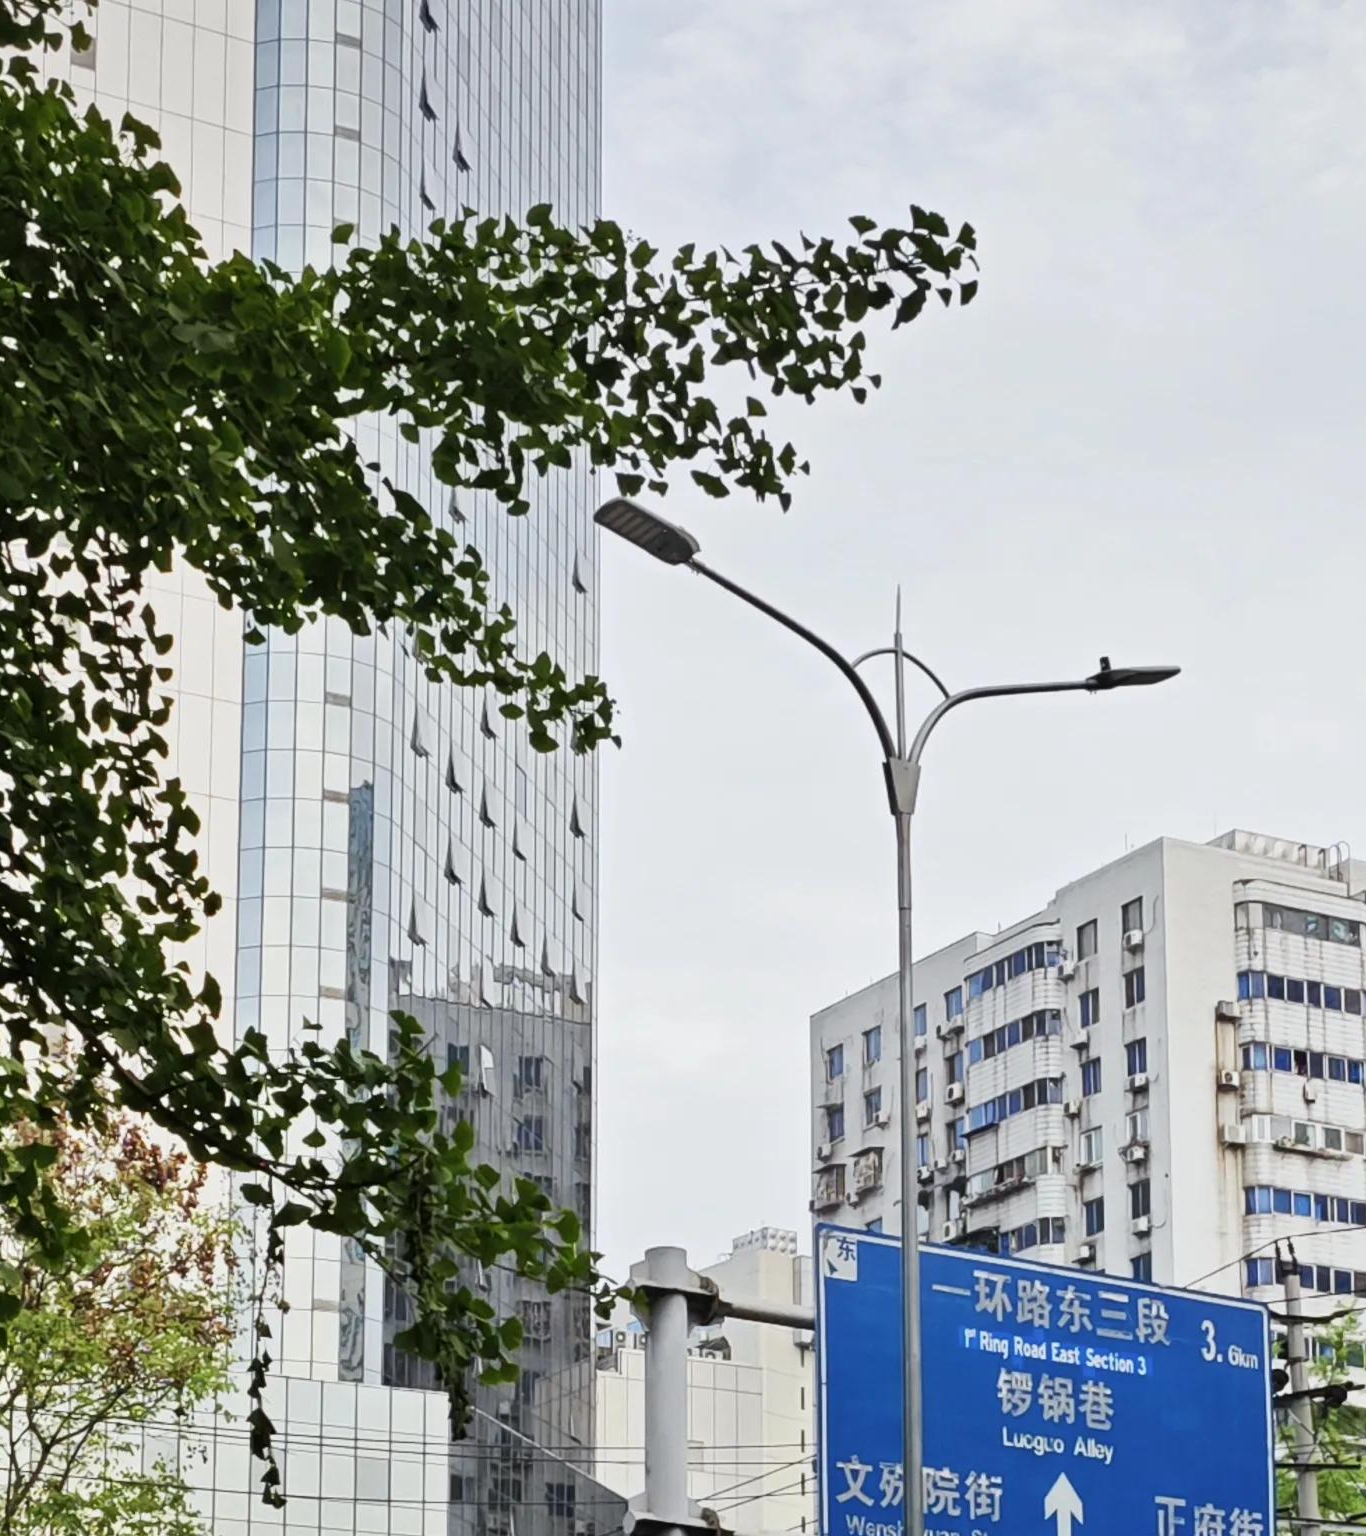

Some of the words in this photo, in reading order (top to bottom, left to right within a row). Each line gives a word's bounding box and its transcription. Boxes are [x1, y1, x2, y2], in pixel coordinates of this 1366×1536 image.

[836, 1236, 856, 1262] 东
[931, 1269, 1171, 1346] 一环路东三段
[979, 1331, 1009, 1359] Ring
[1014, 1336, 1047, 1361] Road
[1051, 1343, 1081, 1366] East
[1085, 1346, 1135, 1375] Section
[1137, 1356, 1148, 1376] 3
[1002, 1426, 1065, 1456] Luoguo
[1073, 1436, 1115, 1465] Alley
